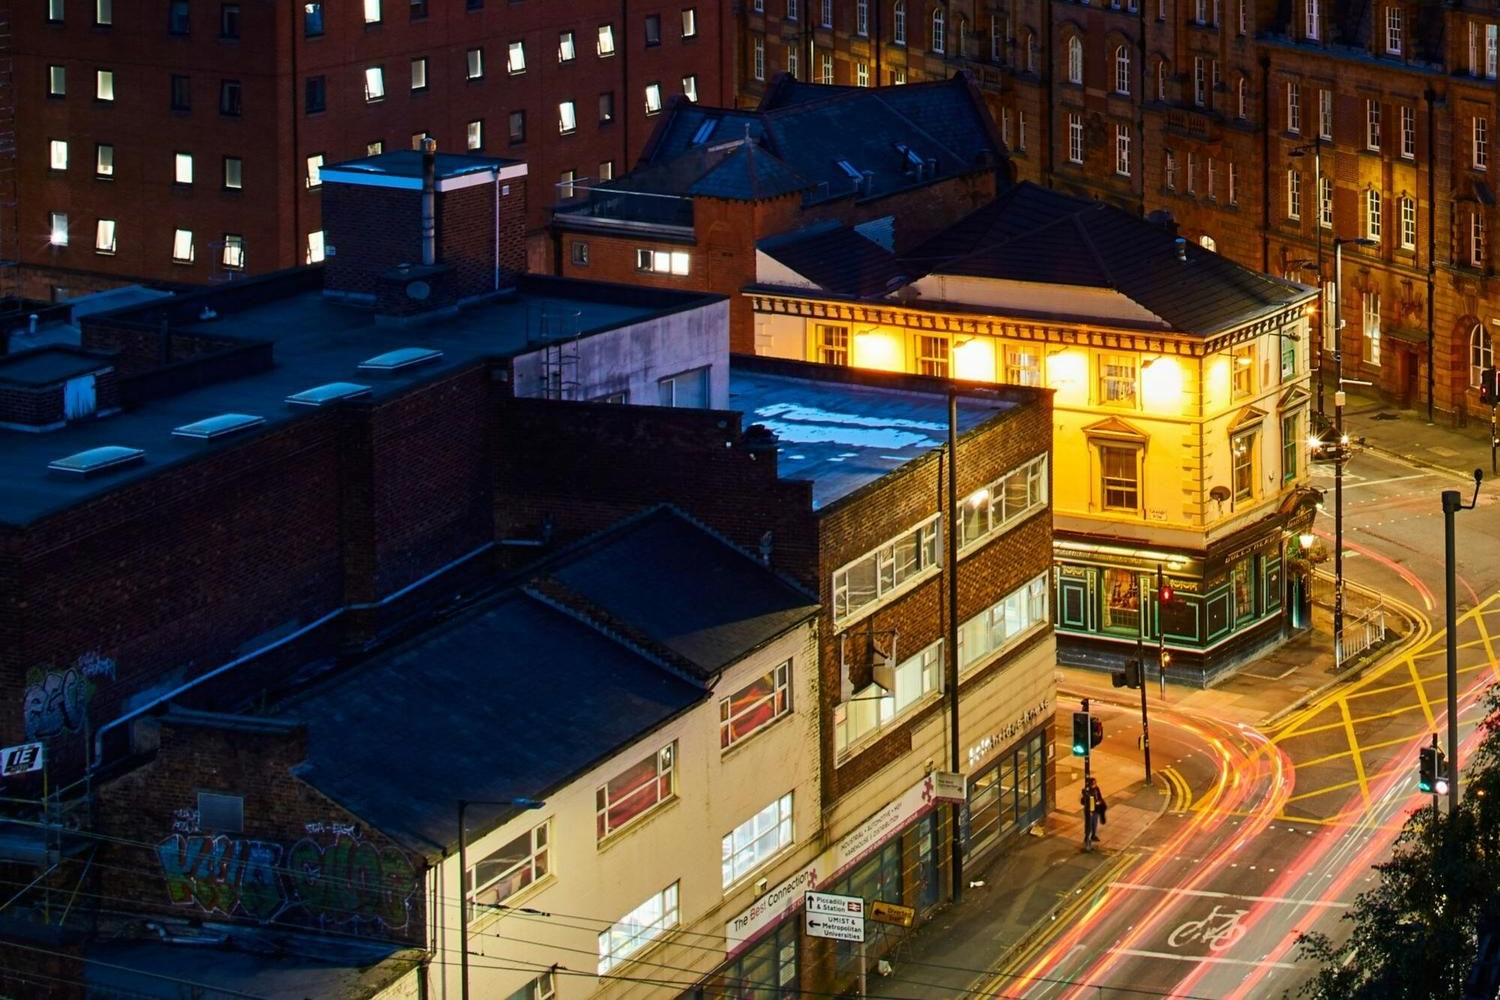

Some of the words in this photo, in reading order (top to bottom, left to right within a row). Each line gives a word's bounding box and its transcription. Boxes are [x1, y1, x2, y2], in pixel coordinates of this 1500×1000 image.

[734, 915, 748, 932] The
[749, 902, 767, 921] Best
[767, 871, 809, 907] Connection
[816, 896, 846, 907] Piccadilly
[823, 904, 846, 913] Station
[822, 922, 862, 933] Metropolitan
[823, 930, 861, 939] Universities
